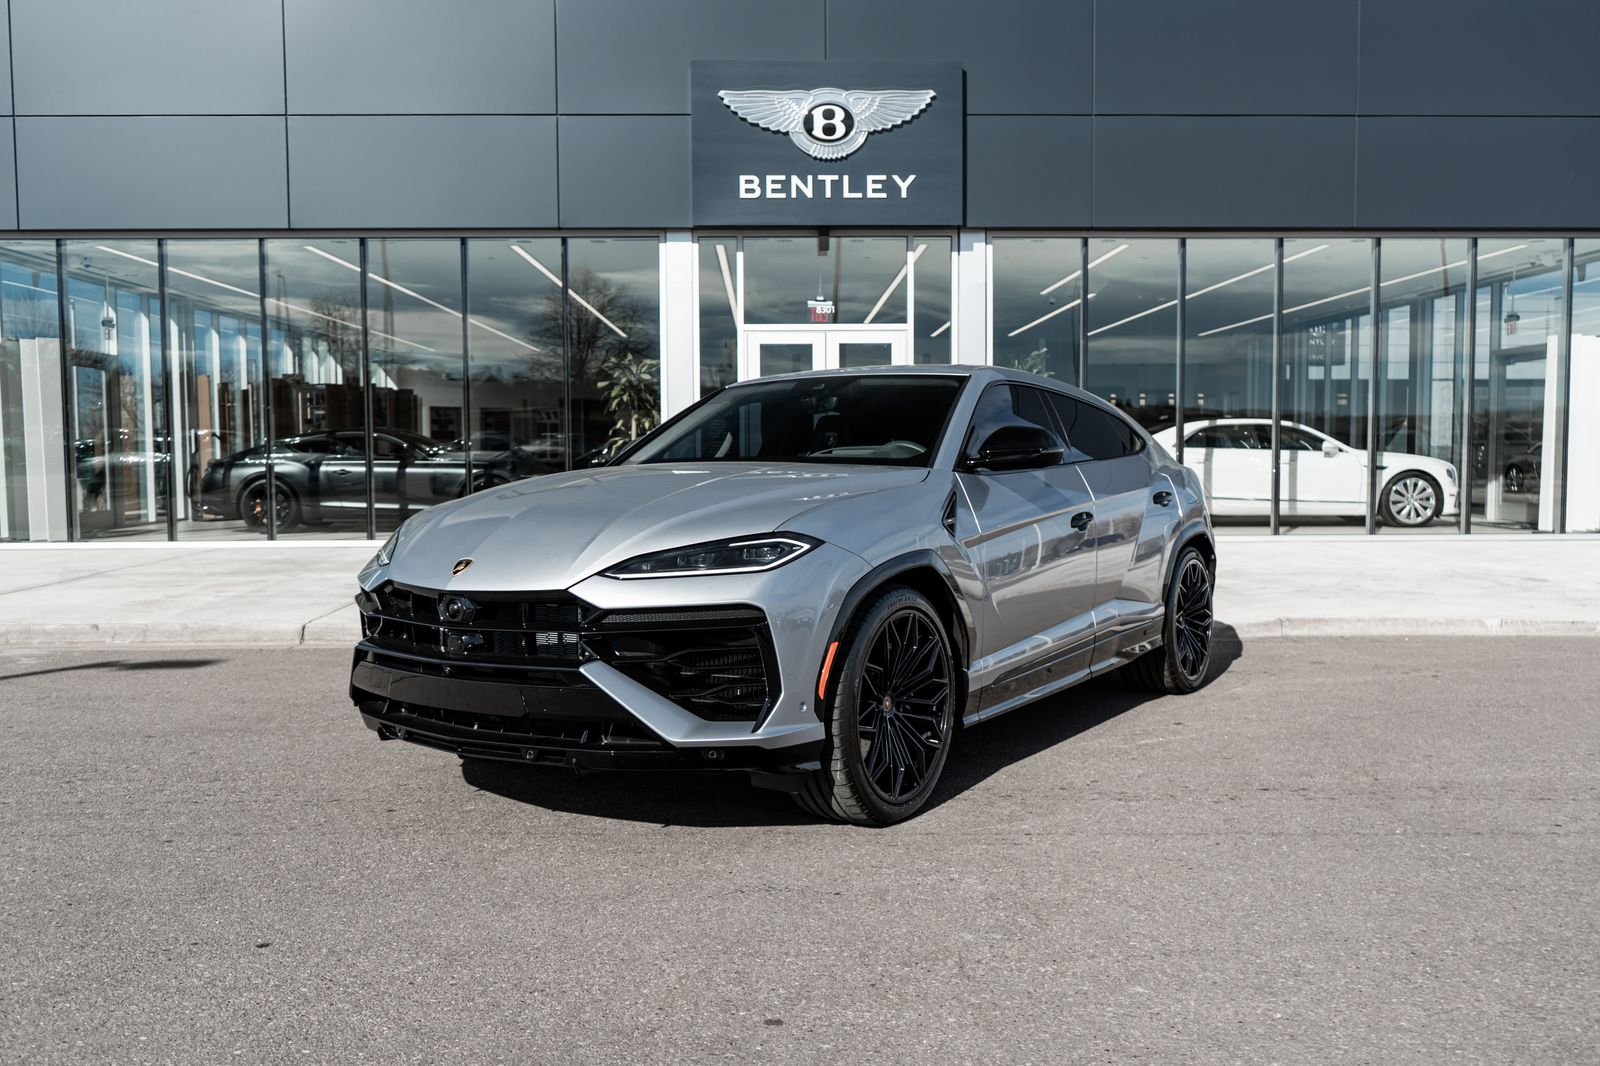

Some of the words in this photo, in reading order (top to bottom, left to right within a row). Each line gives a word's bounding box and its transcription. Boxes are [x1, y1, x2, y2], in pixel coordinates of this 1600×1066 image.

[811, 104, 847, 140] B
[738, 174, 917, 199] BENTLEY
[815, 305, 836, 314] 8301
